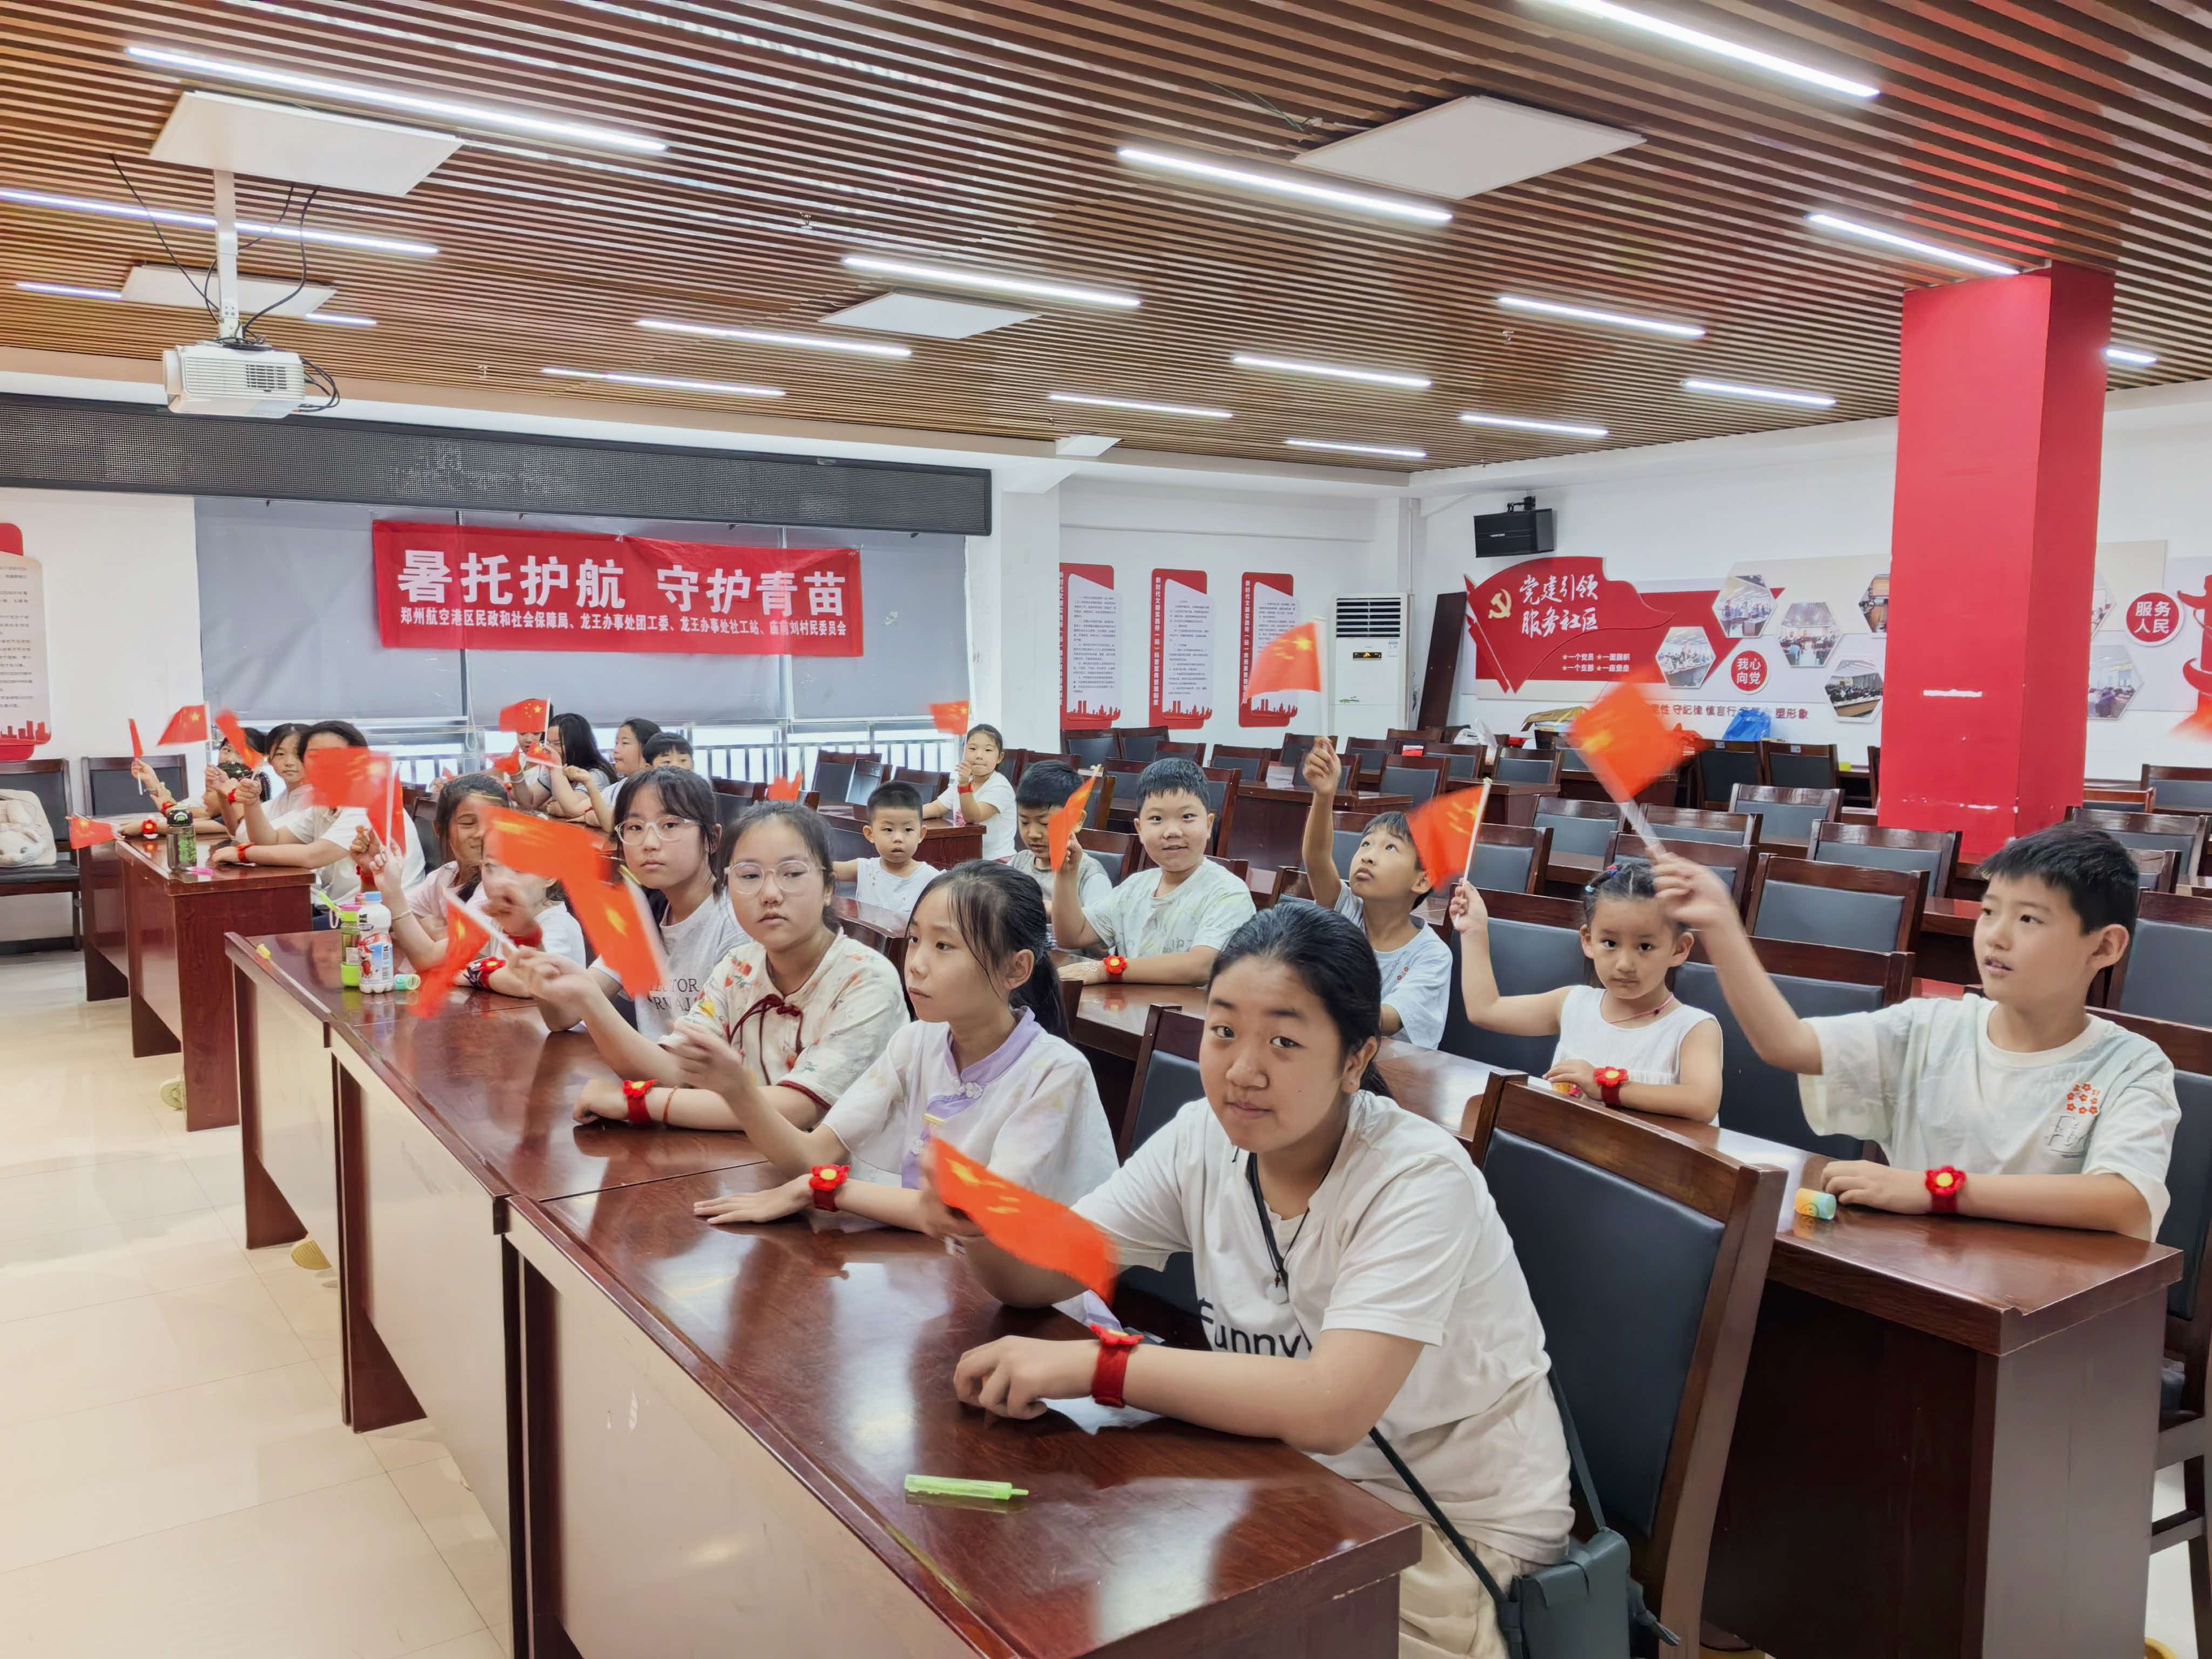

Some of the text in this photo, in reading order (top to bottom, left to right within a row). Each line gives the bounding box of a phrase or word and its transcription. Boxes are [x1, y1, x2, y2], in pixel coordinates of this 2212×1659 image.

[397, 549, 846, 617] 暑托护航 守护青苗
[1519, 574, 1599, 605] 党建引领
[2135, 601, 2171, 617] 服务
[1521, 606, 1599, 639] 服务社区
[2134, 618, 2169, 634] 人民
[1568, 653, 1594, 661] 一个党员
[1737, 658, 1761, 670] 我心
[1737, 672, 1761, 684] 向党
[1775, 707, 1809, 719] 塑形象
